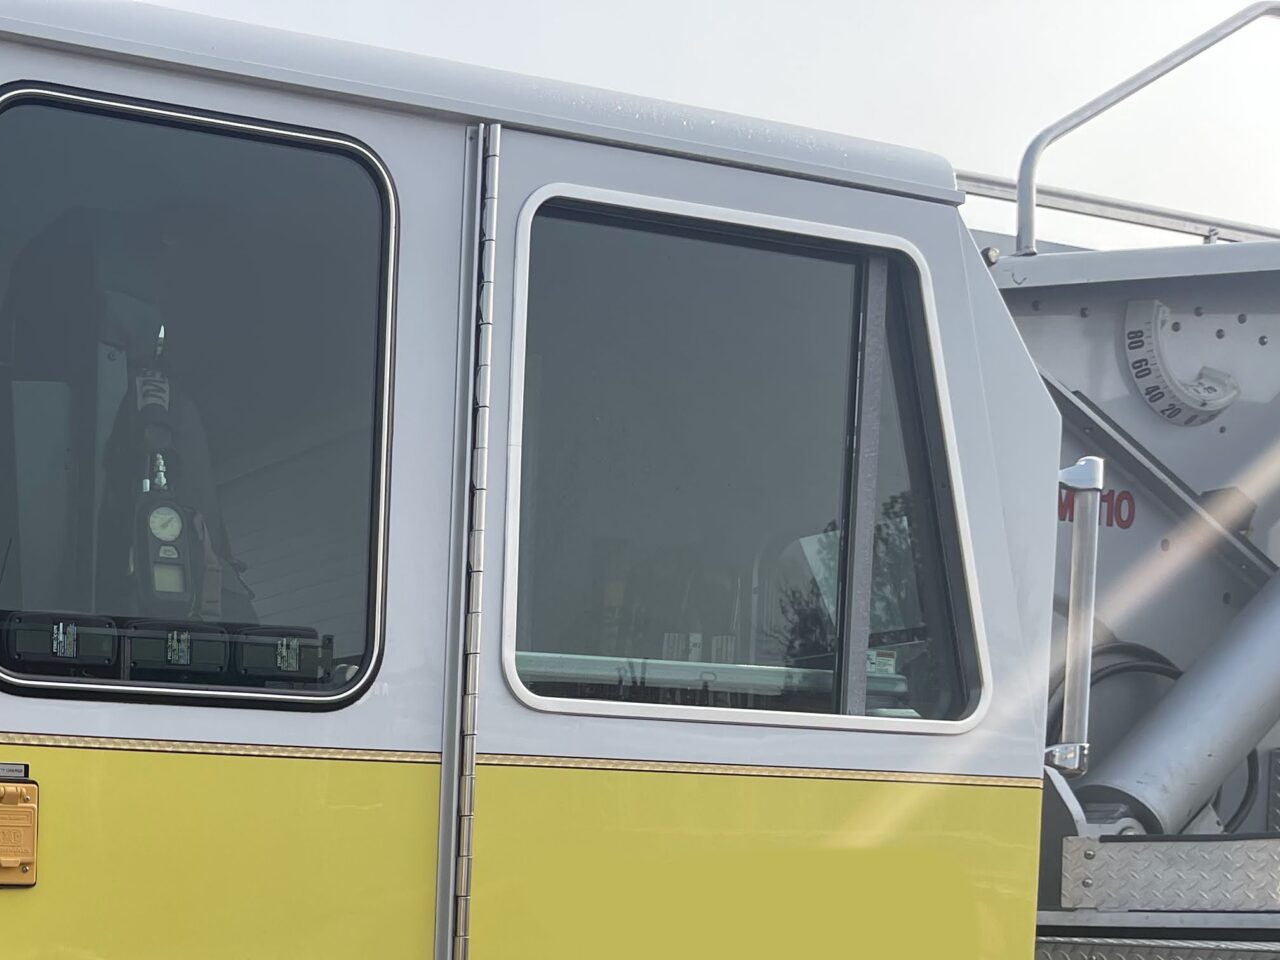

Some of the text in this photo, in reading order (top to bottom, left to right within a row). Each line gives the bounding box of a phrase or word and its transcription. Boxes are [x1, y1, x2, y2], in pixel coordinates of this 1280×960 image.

[1127, 330, 1145, 351] 80
[1131, 358, 1152, 379] 60
[1144, 385, 1165, 403] 40
[1160, 403, 1182, 419] 20
